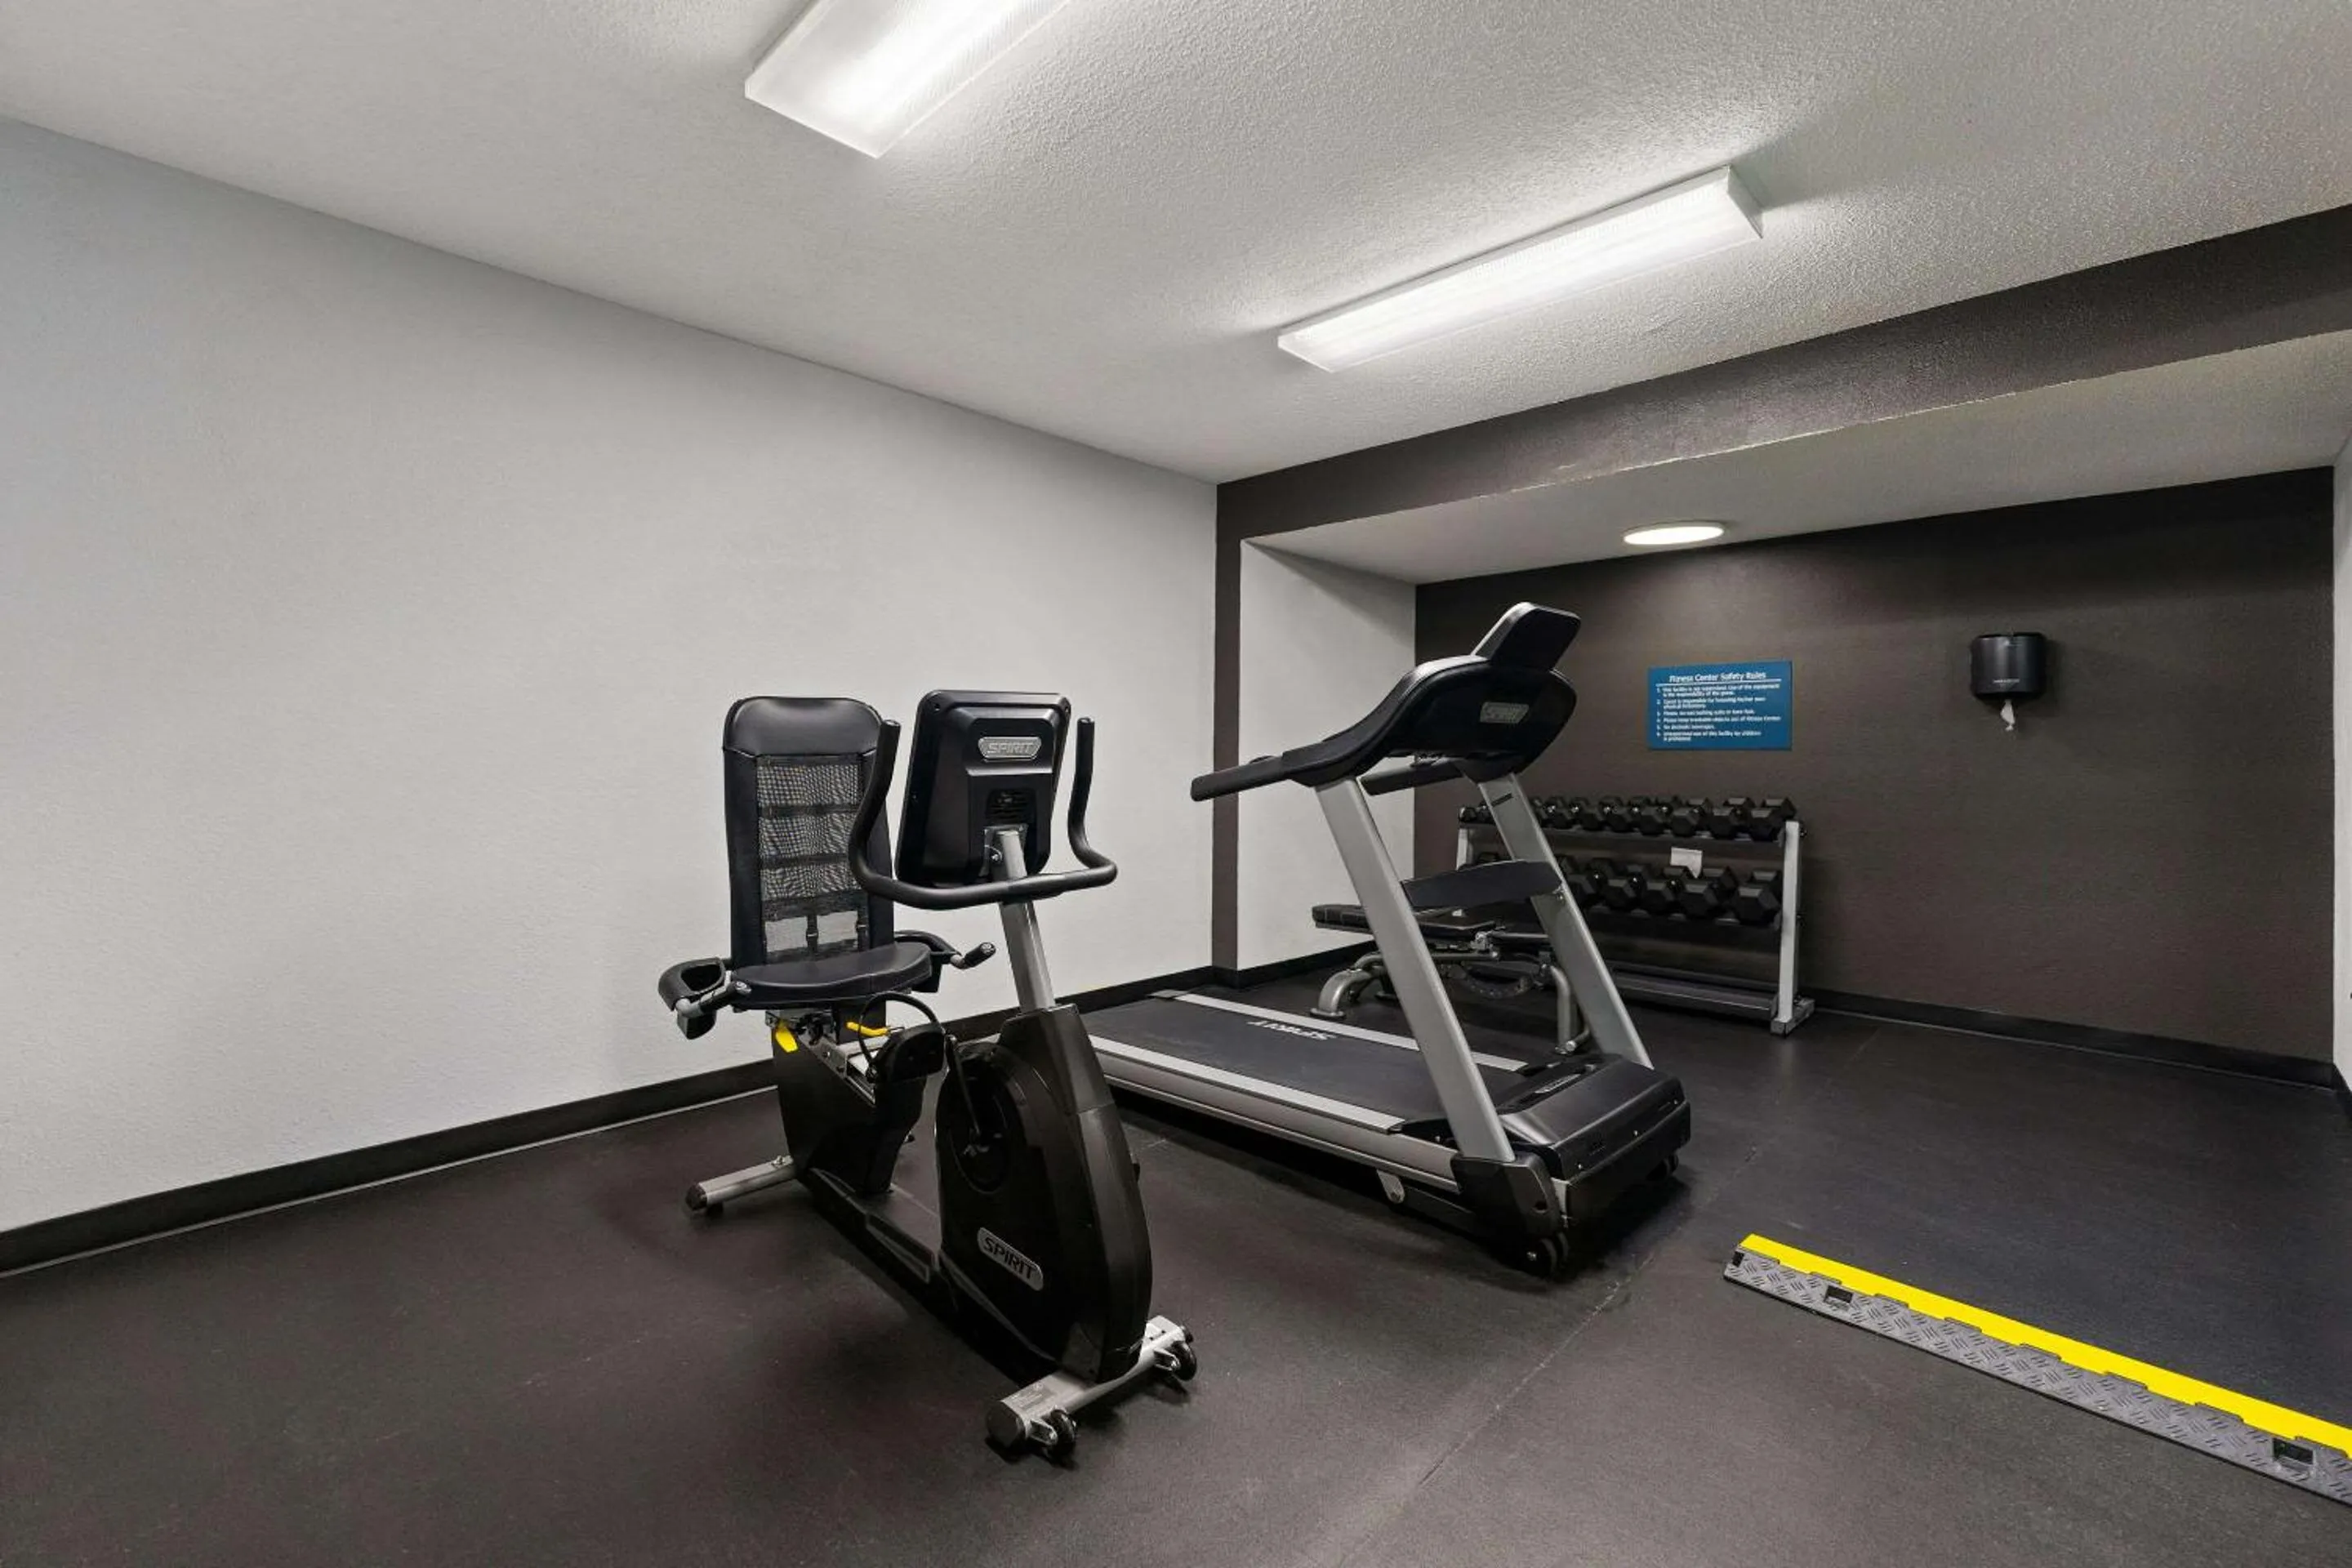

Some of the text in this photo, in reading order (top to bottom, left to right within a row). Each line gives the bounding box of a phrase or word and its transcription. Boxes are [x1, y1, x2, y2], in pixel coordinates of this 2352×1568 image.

[1721, 672, 1744, 680] Safety
[987, 742, 1035, 753] SPIRIT
[983, 1236, 1037, 1279] SPIRIT
